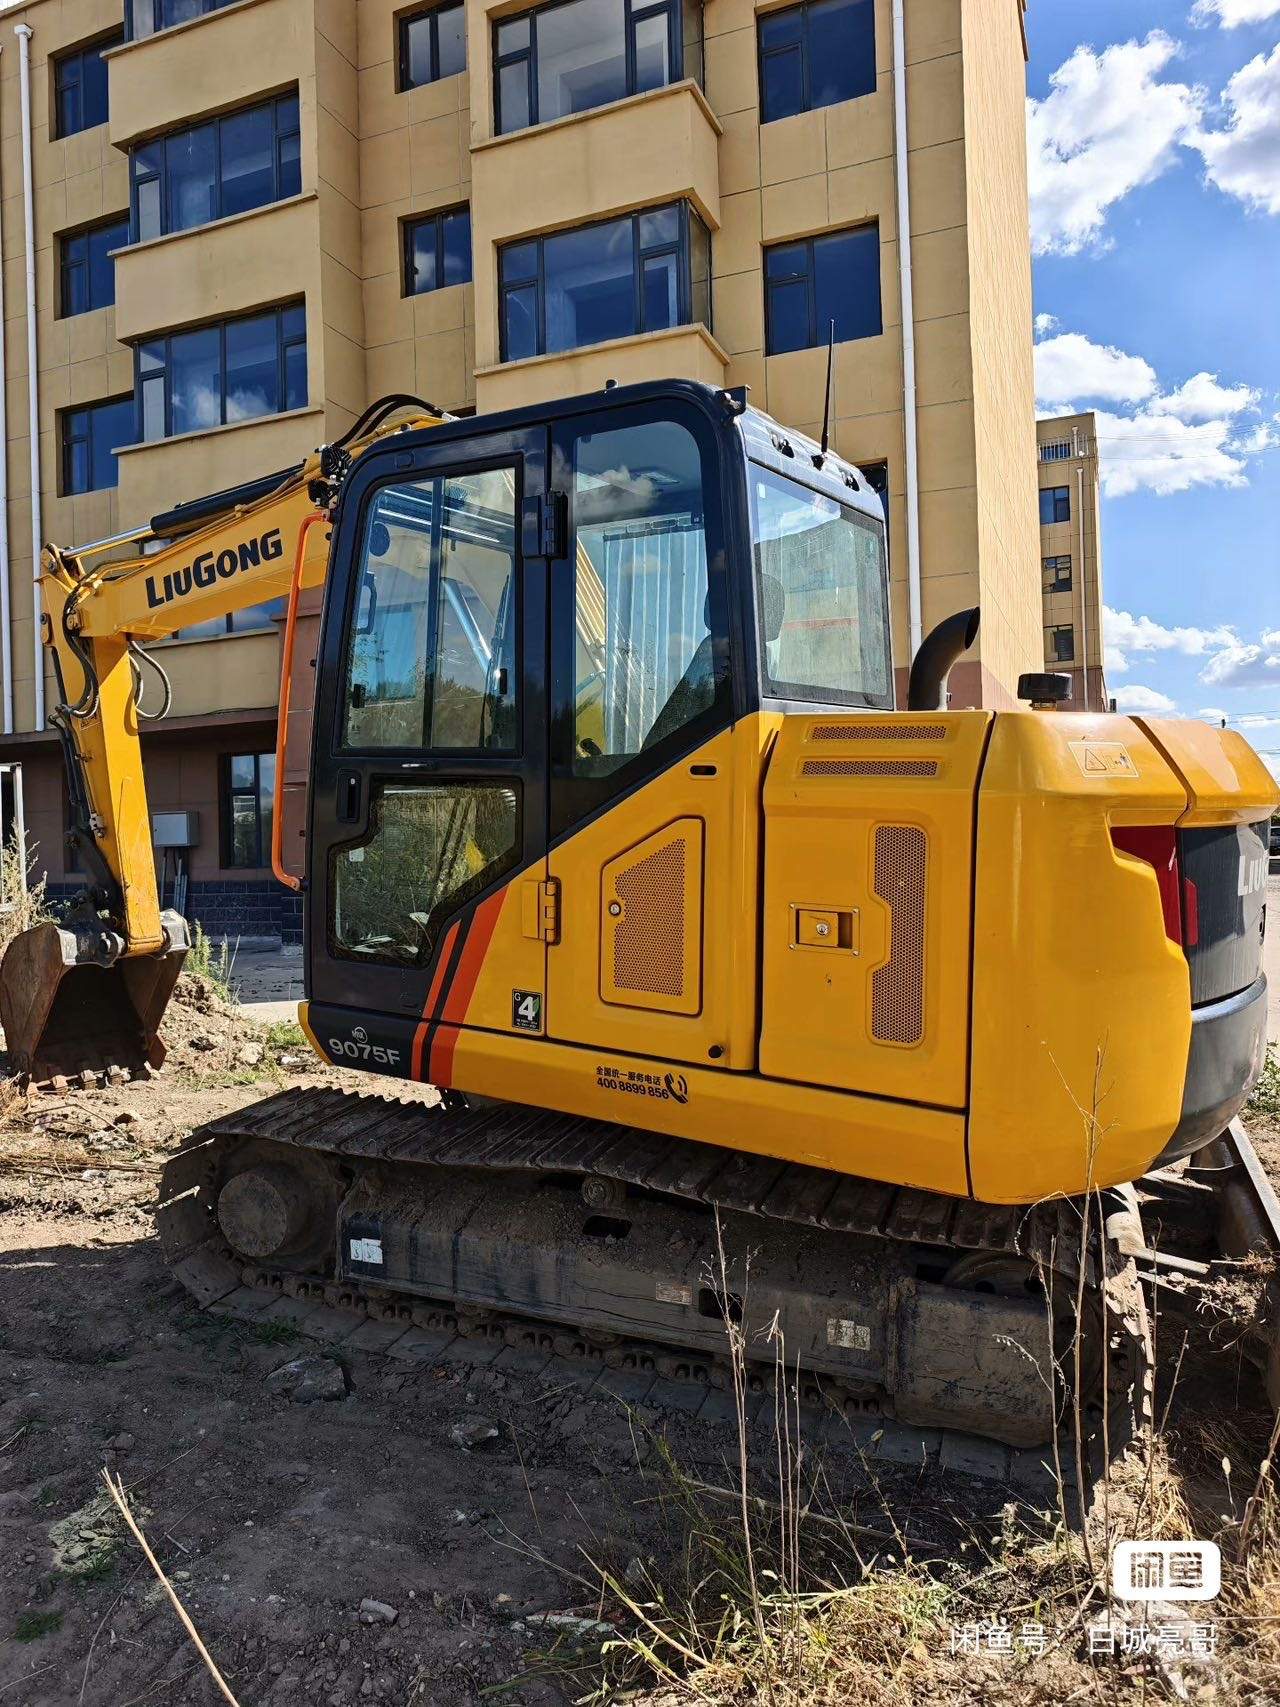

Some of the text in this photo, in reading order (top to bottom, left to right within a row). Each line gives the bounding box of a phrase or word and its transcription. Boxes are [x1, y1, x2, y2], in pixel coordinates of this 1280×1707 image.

[145, 528, 283, 609] LIUGONG
[518, 996, 535, 1021] 4
[328, 1038, 400, 1065] 9075F
[596, 1065, 661, 1086] 全国统一服务电话
[597, 1077, 669, 1099] 400 8899 856
